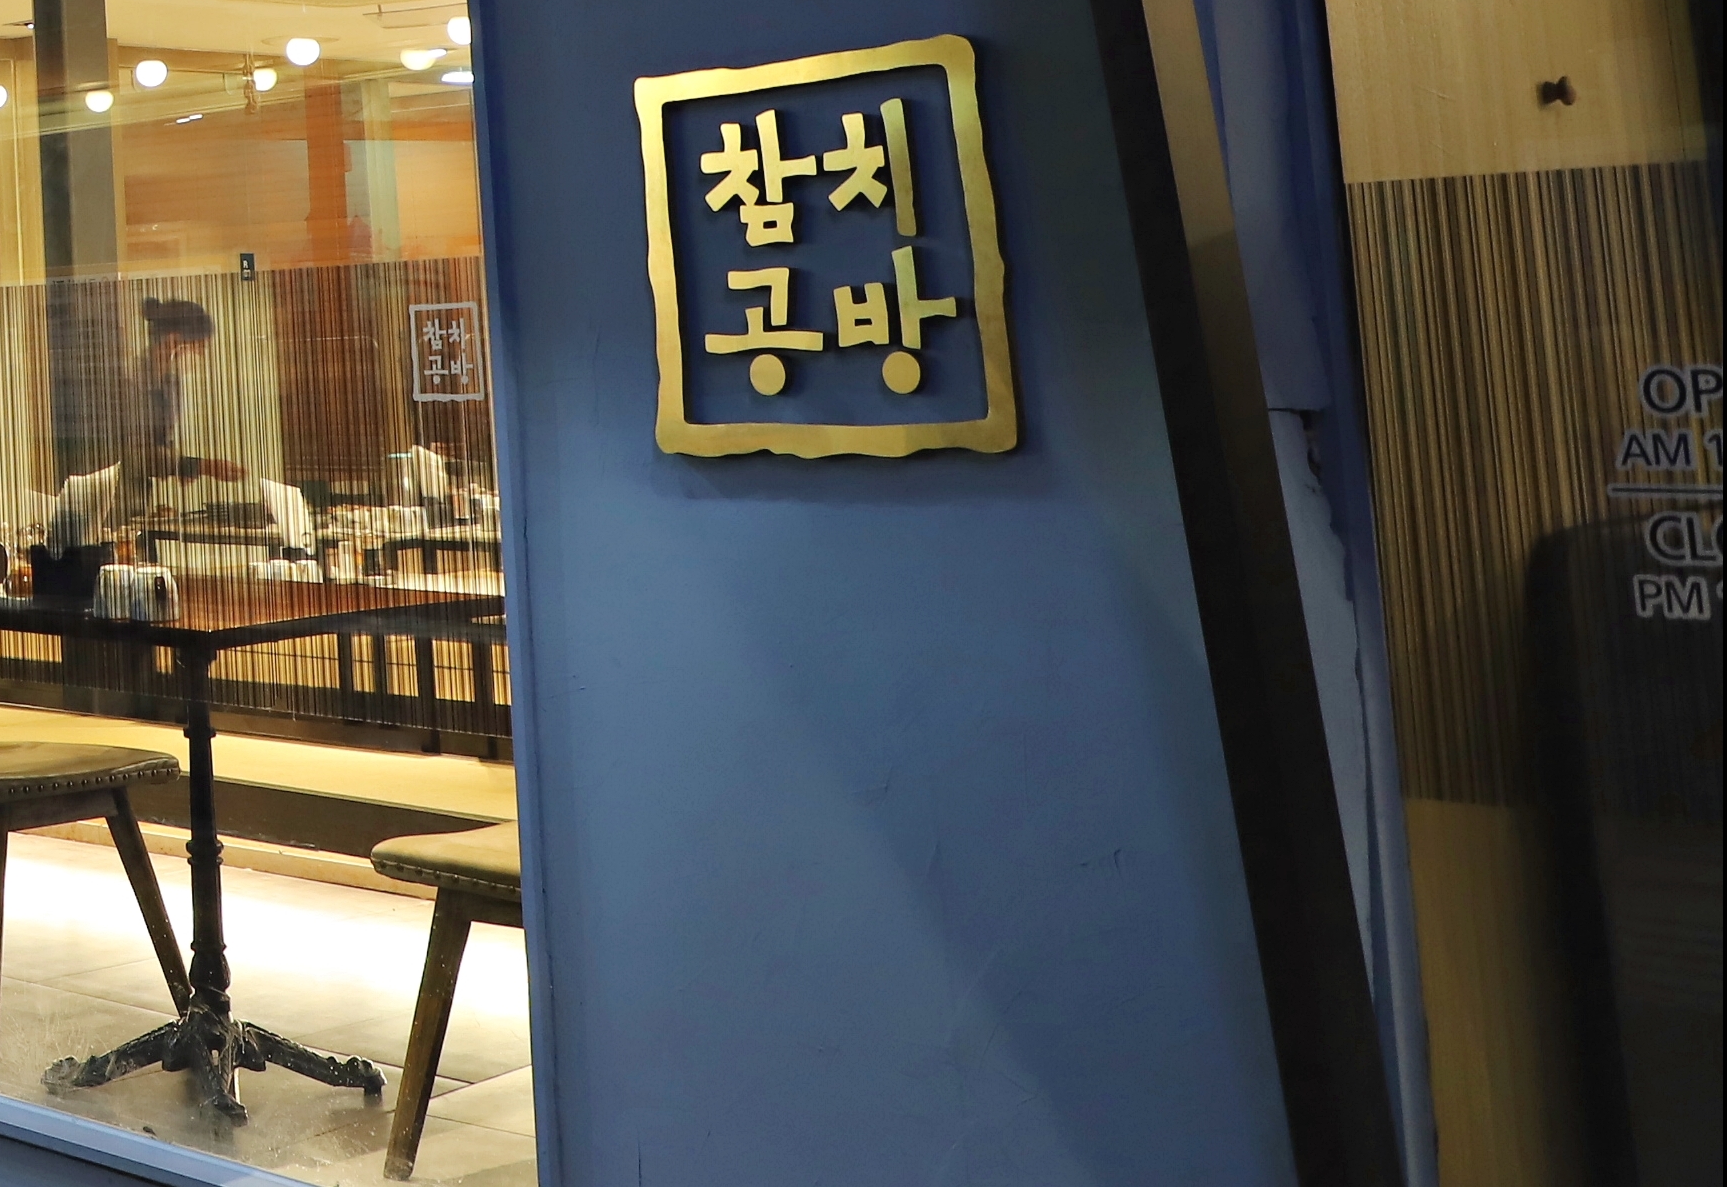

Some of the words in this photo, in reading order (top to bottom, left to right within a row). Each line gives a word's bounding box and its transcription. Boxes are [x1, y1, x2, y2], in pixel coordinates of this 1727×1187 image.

[700, 98, 917, 247] 참치
[243, 260, 249, 269] R
[423, 318, 466, 351] 참치
[705, 245, 957, 395] 공방
[424, 353, 473, 385] 공방
[1619, 430, 1694, 468] AM
[1647, 514, 1723, 562] CL
[1635, 576, 1708, 617] PM
